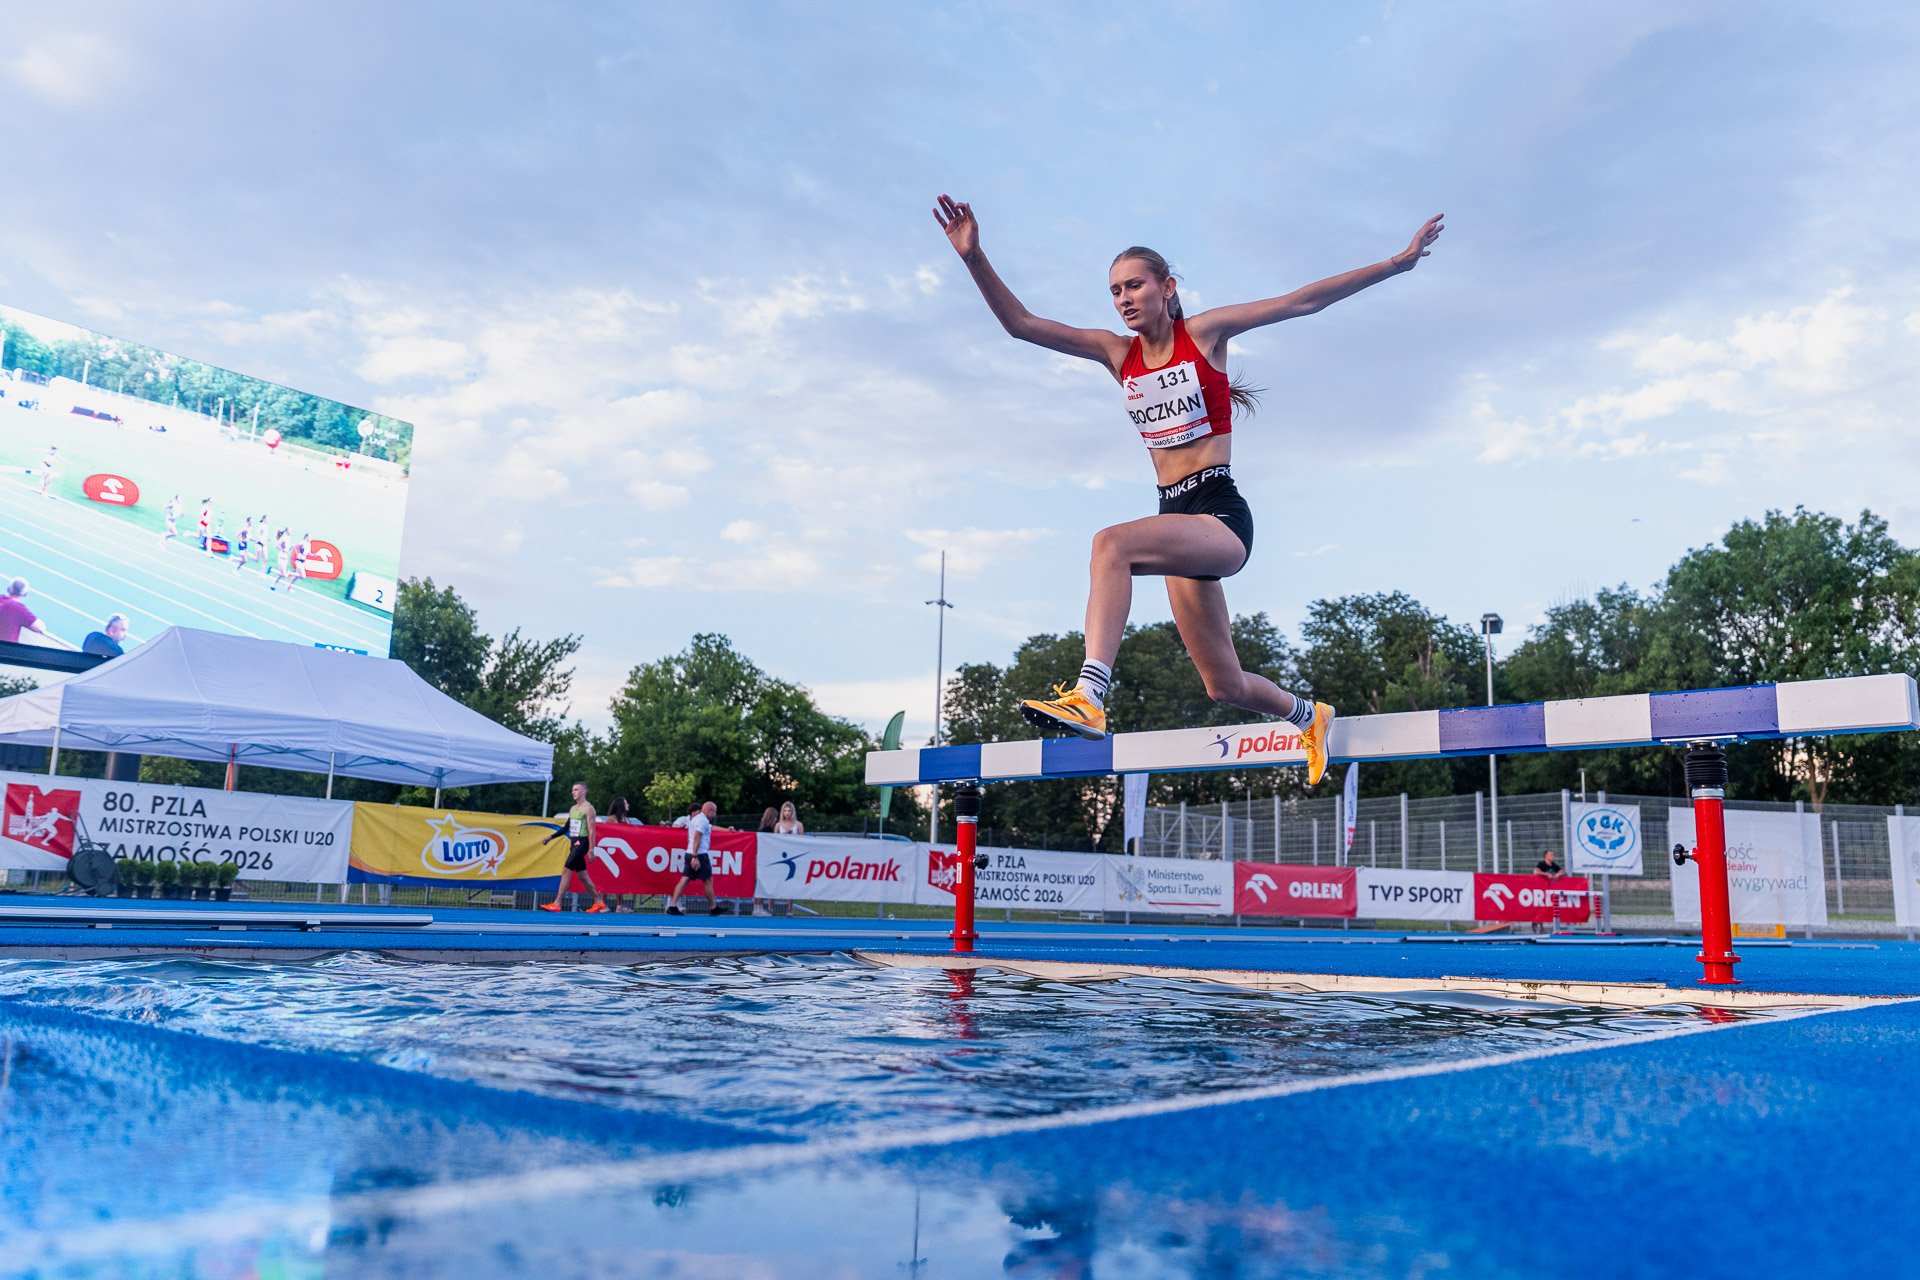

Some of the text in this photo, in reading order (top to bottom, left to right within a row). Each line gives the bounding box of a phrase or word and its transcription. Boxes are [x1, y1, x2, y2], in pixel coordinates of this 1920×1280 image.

[1157, 368, 1190, 390] 131
[1127, 393, 1144, 401] ORLEN
[1129, 393, 1202, 425] BOCZKAN
[1176, 431, 1195, 442] 2026
[1165, 474, 1198, 500] NIKE
[375, 589, 384, 604] 2
[1236, 729, 1306, 760] polan
[103, 791, 207, 819] 80. PZLA
[98, 816, 334, 847] MISTRZOSTWA POLSKI U20
[1586, 815, 1624, 834] PGK
[219, 849, 274, 871] 2026
[442, 838, 490, 863] LOTTO
[646, 846, 743, 876] OREN
[997, 855, 1027, 869] PZLA
[975, 870, 1041, 883] MISTRZOSTWA
[1043, 873, 1076, 885] POLSKI
[1078, 875, 1096, 886] U20
[1147, 868, 1205, 881] Ministerstwo
[1730, 875, 1808, 892] wygrywać!
[974, 884, 1064, 903] ZAMOŚĆ 2026
[1147, 882, 1177, 895] Sportu
[1183, 883, 1222, 896] Turystyki
[1288, 881, 1343, 900] ORLEN
[1368, 884, 1464, 904] TVP SPORT
